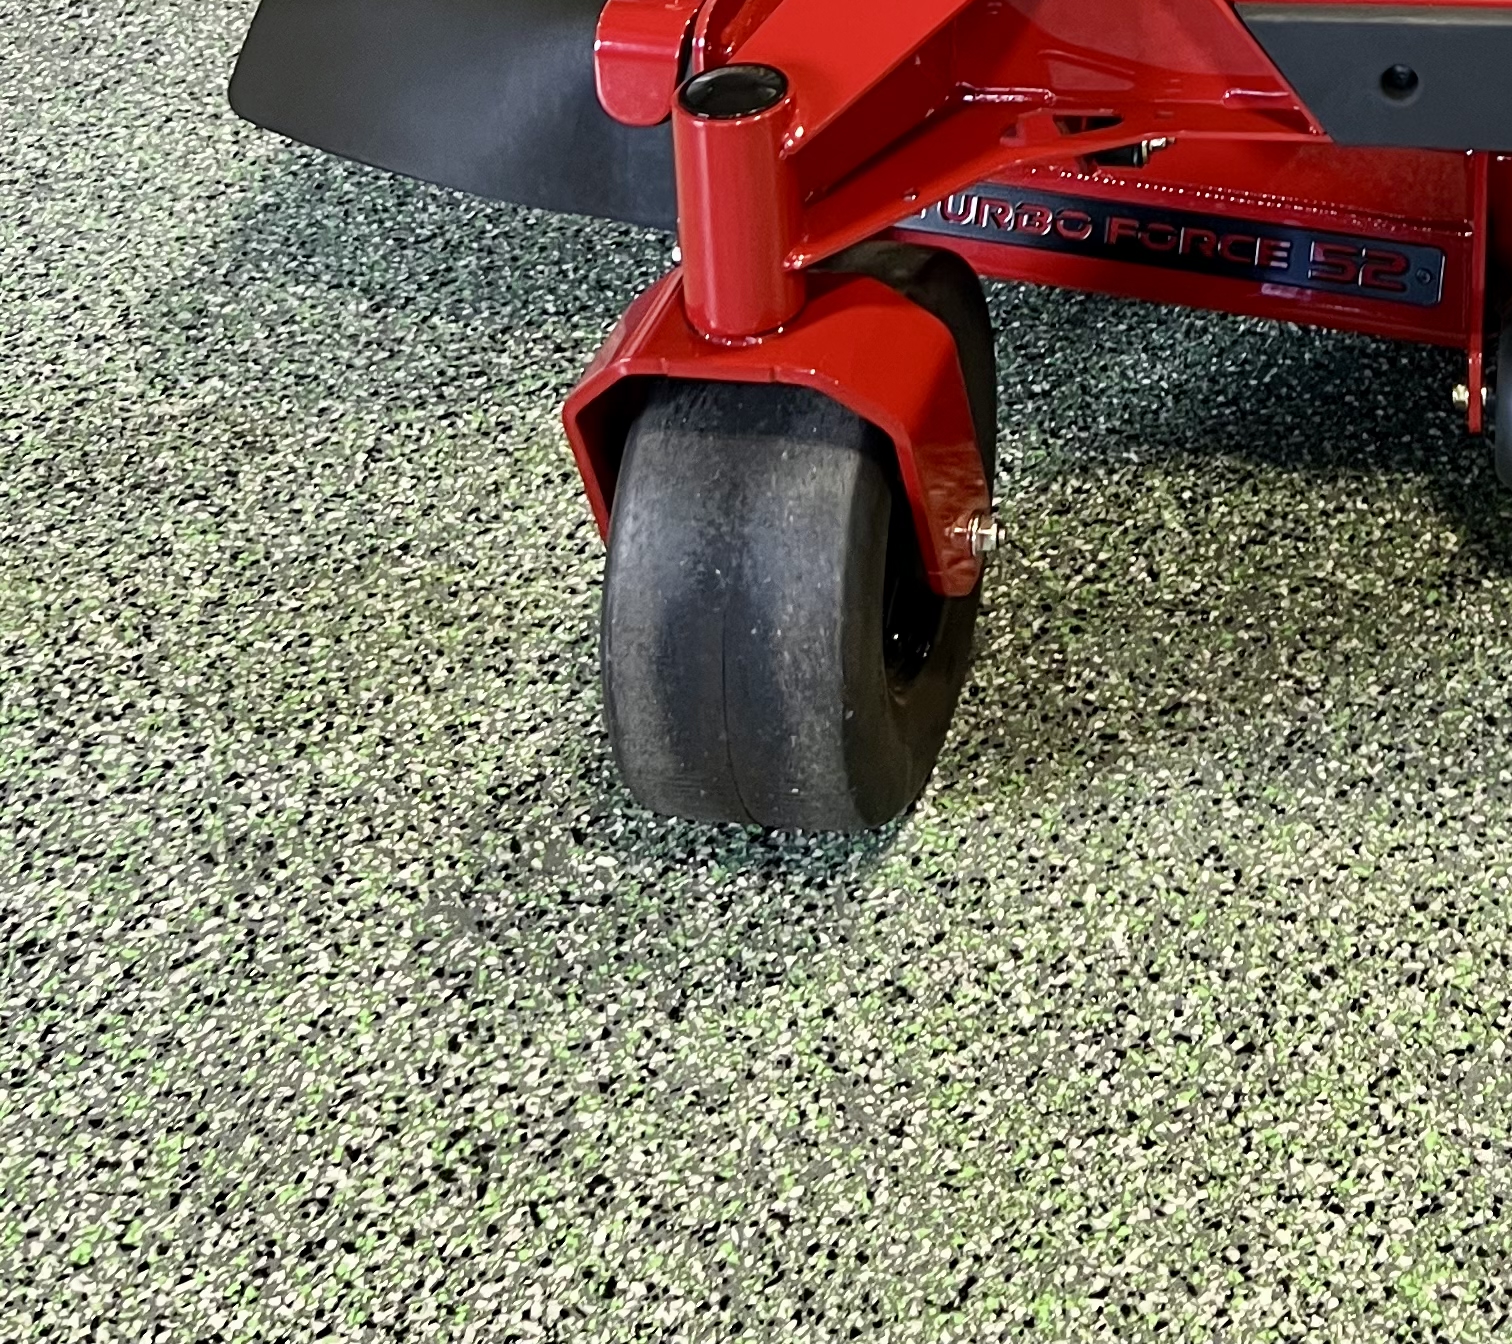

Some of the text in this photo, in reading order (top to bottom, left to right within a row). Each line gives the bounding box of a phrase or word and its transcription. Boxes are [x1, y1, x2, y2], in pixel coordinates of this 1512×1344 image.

[920, 195, 1410, 293] URBO FORCE 52
